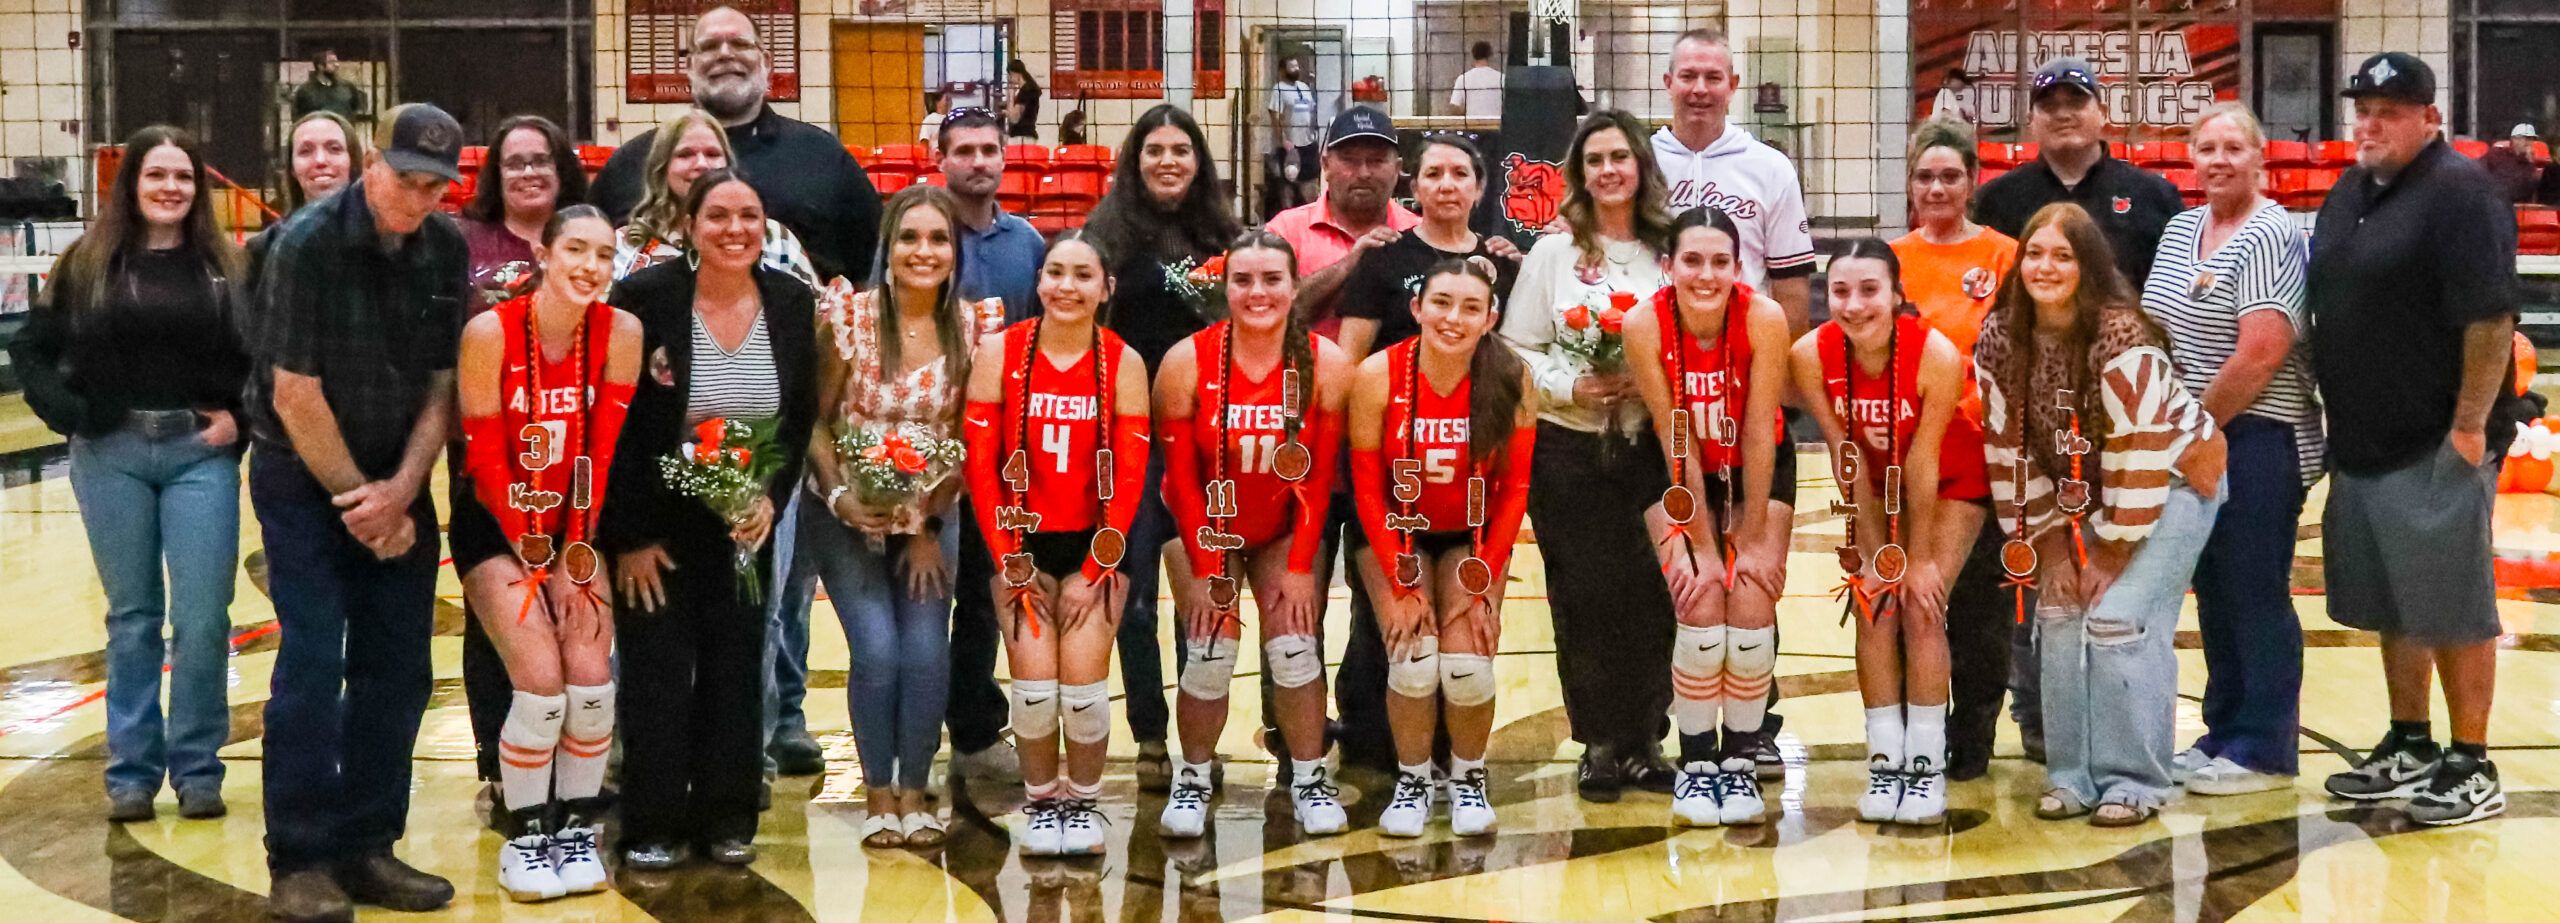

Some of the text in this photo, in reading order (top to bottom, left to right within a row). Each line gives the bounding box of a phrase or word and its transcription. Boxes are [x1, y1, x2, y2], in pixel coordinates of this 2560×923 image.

[1963, 30, 2194, 77] ARTESIA
[519, 423, 552, 471] 3
[1041, 423, 1071, 474] 4
[1238, 434, 1276, 475] 11
[1424, 447, 1457, 485] 5
[1838, 440, 1860, 484] 6
[1002, 449, 1029, 492] 4
[1392, 458, 1422, 503] 5
[1206, 479, 1238, 518] 11
